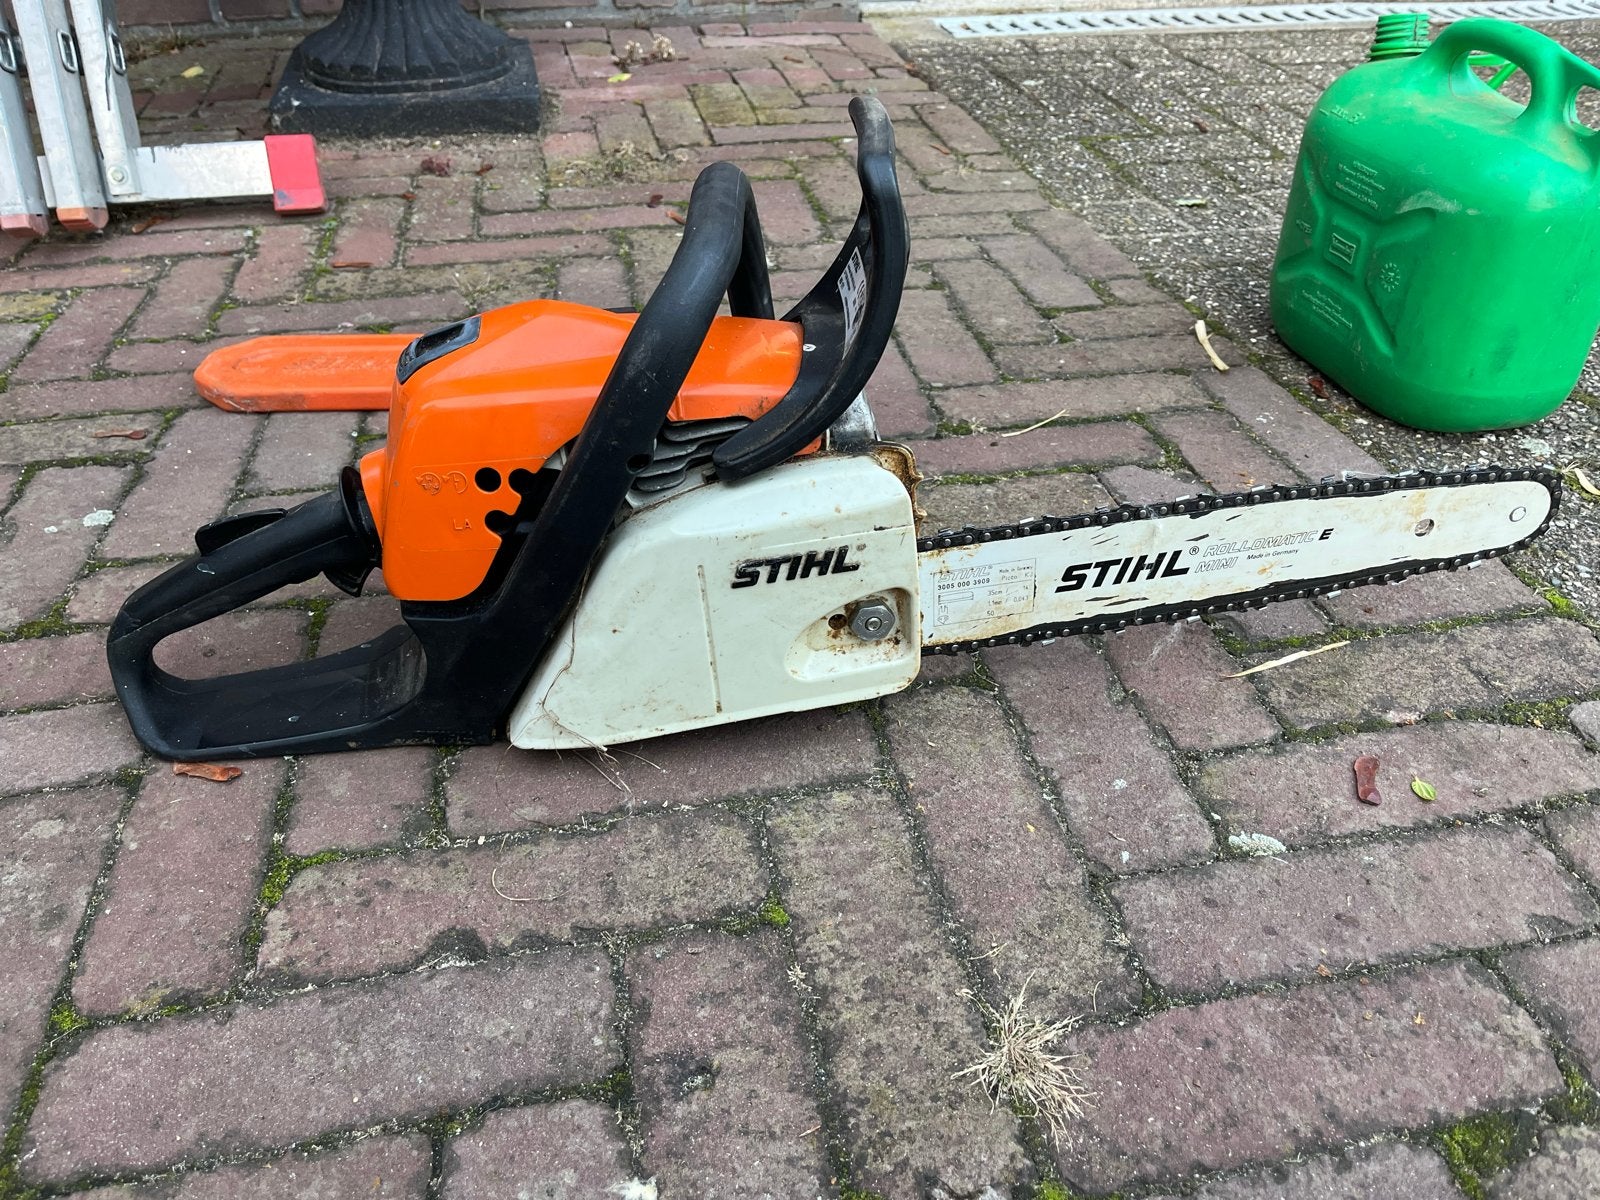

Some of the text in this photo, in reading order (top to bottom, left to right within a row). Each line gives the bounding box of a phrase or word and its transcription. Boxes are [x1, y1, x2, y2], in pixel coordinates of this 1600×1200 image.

[453, 519, 472, 531] LA
[1202, 528, 1334, 558] ROLLOMATIC E
[1272, 548, 1299, 557] Germany
[731, 545, 860, 589] STIHL
[1054, 549, 1190, 594] STIHL
[1194, 556, 1239, 574] MINI
[957, 580, 970, 588] 000
